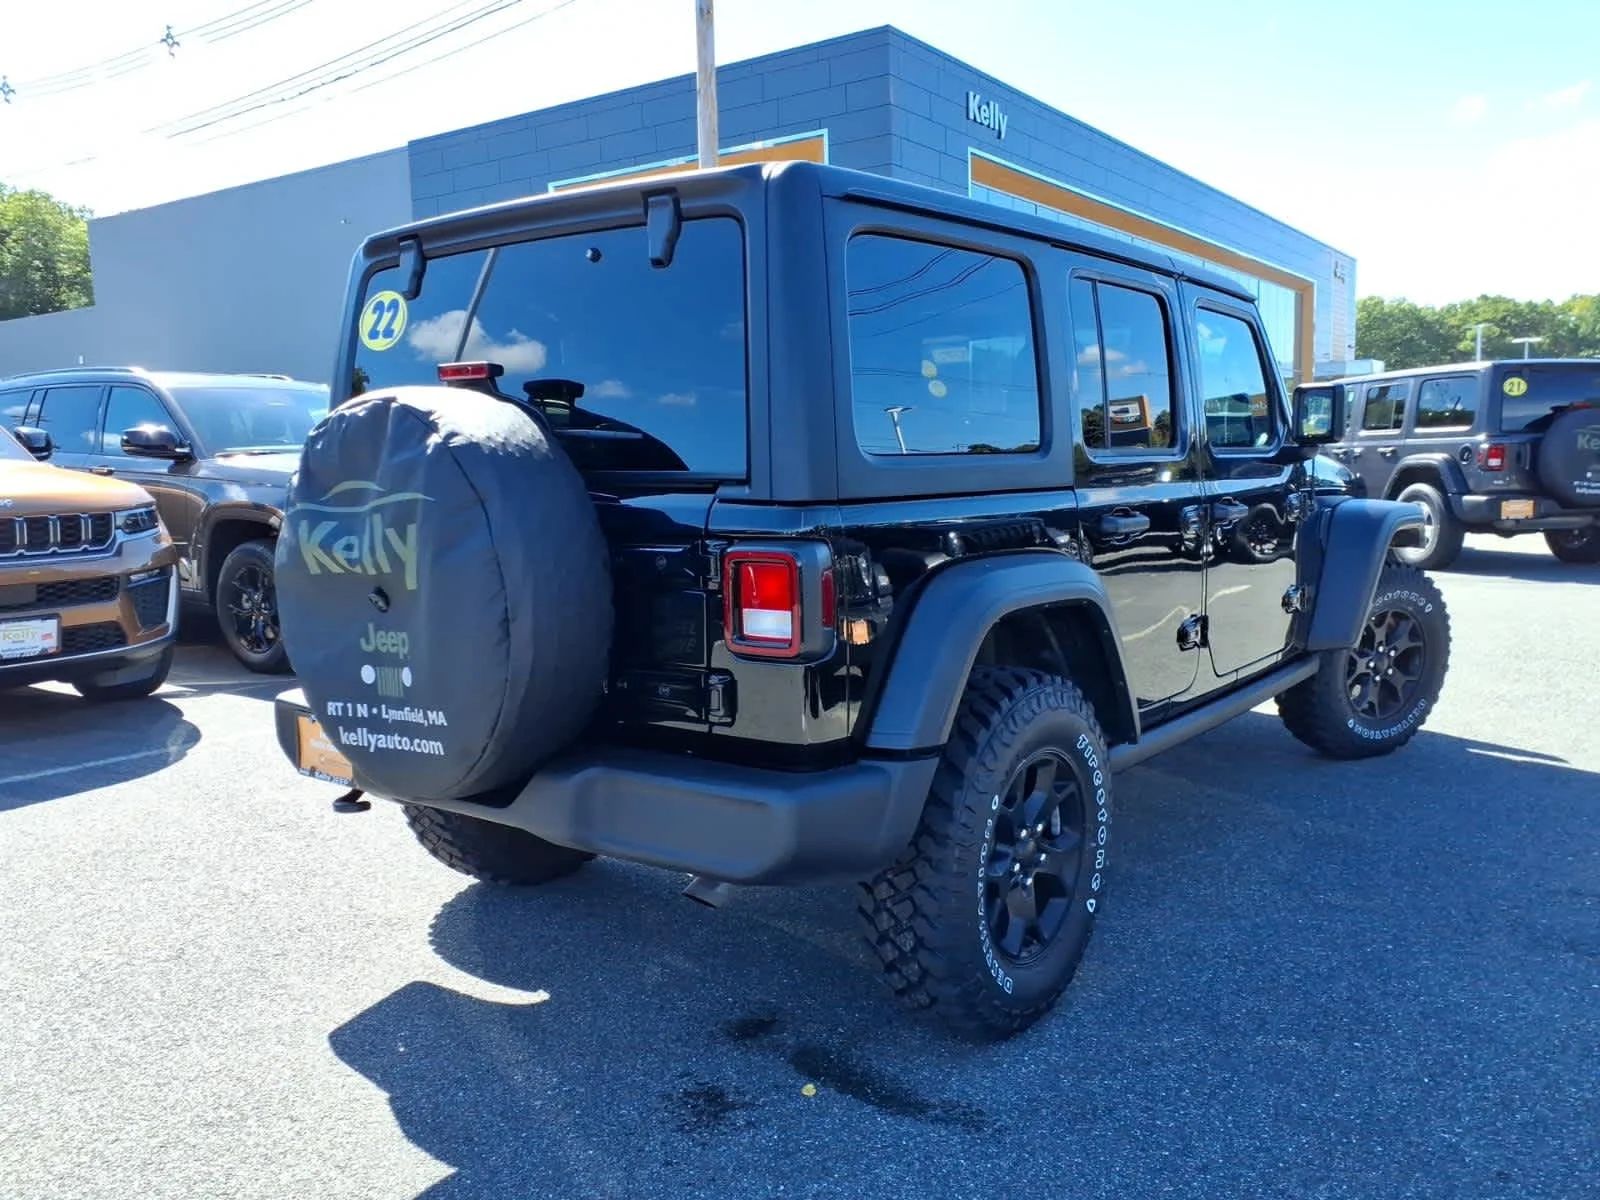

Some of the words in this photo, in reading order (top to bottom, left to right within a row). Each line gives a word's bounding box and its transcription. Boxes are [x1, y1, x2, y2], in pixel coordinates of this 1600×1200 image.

[967, 91, 1008, 140] Kelly
[368, 298, 400, 340] 22
[1508, 382, 1521, 393] 21
[298, 513, 418, 590] Kelly
[359, 622, 409, 660] Jeep
[327, 701, 344, 717] RT
[346, 703, 353, 718] 1
[356, 703, 369, 719] N
[338, 726, 445, 756] kellyauto.com
